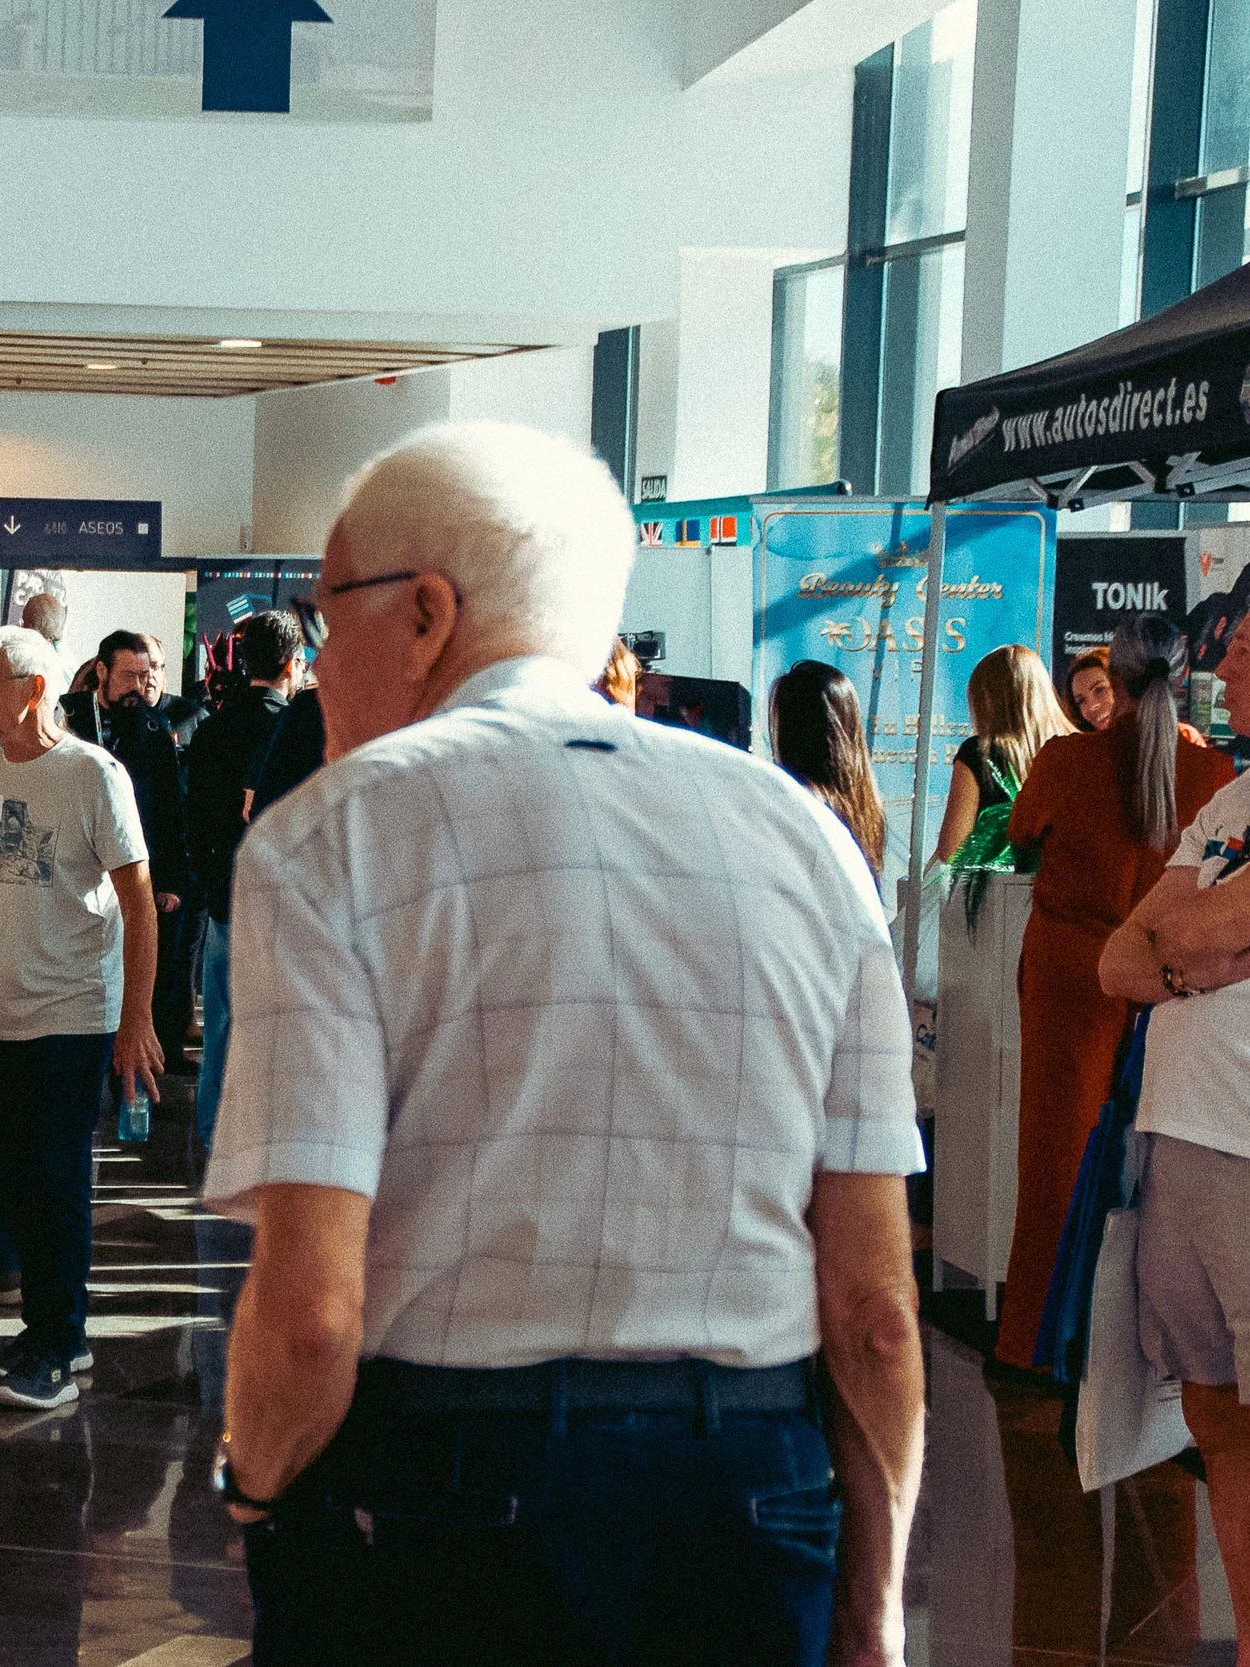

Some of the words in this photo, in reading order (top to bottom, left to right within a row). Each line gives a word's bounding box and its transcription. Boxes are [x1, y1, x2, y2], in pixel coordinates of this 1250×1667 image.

[1002, 377, 1210, 452] www.autosdirect.es
[78, 520, 124, 535] ASEOS
[798, 572, 900, 609] Beauty
[820, 616, 967, 654] OASS
